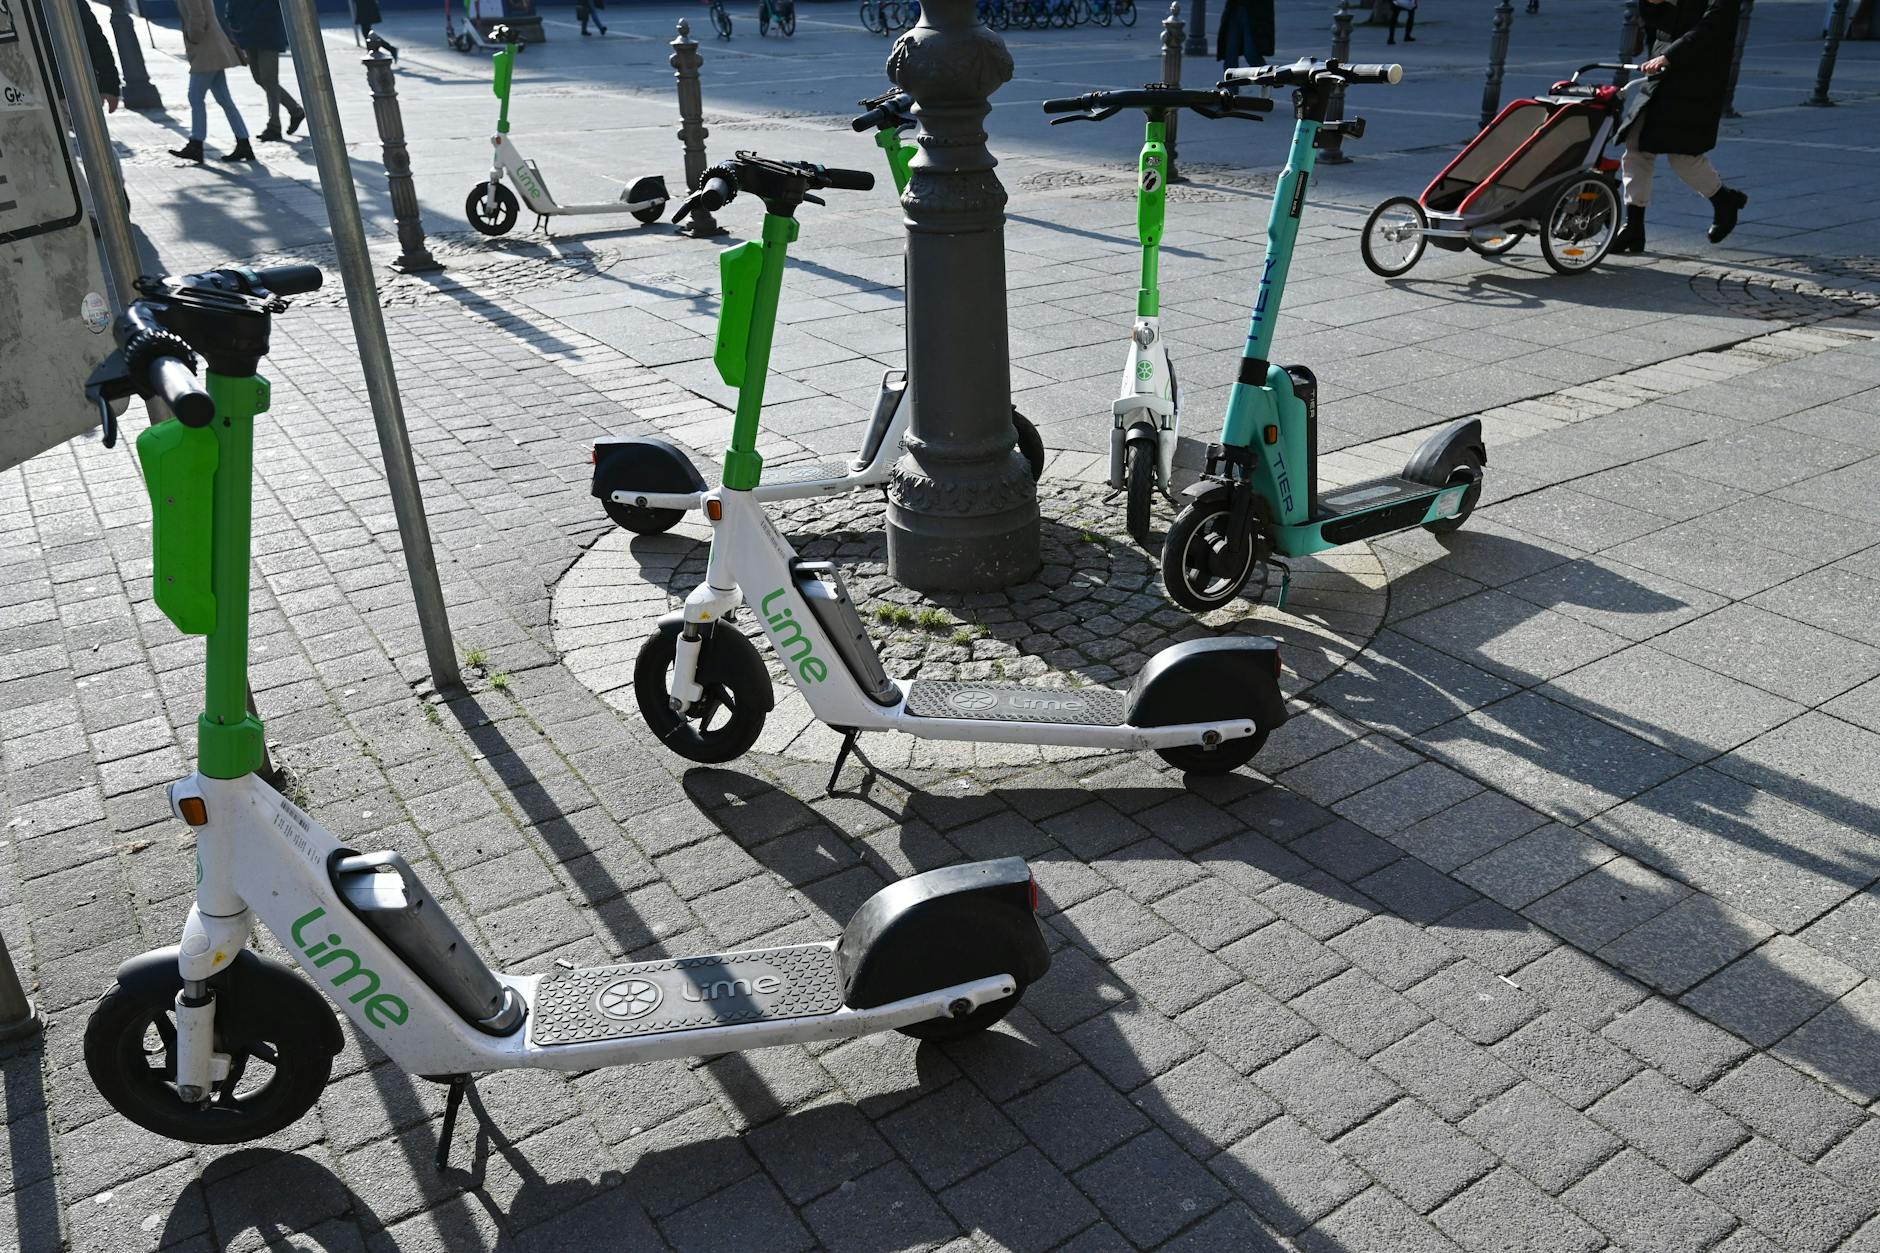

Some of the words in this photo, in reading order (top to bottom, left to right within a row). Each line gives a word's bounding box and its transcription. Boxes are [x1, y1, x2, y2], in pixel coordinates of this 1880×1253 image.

[516, 165, 540, 199] Lime
[1273, 452, 1294, 517] TIER
[761, 587, 828, 684] Lime
[1009, 695, 1084, 711] Lime
[291, 906, 409, 1030] Lime
[681, 974, 782, 1003] Lime
